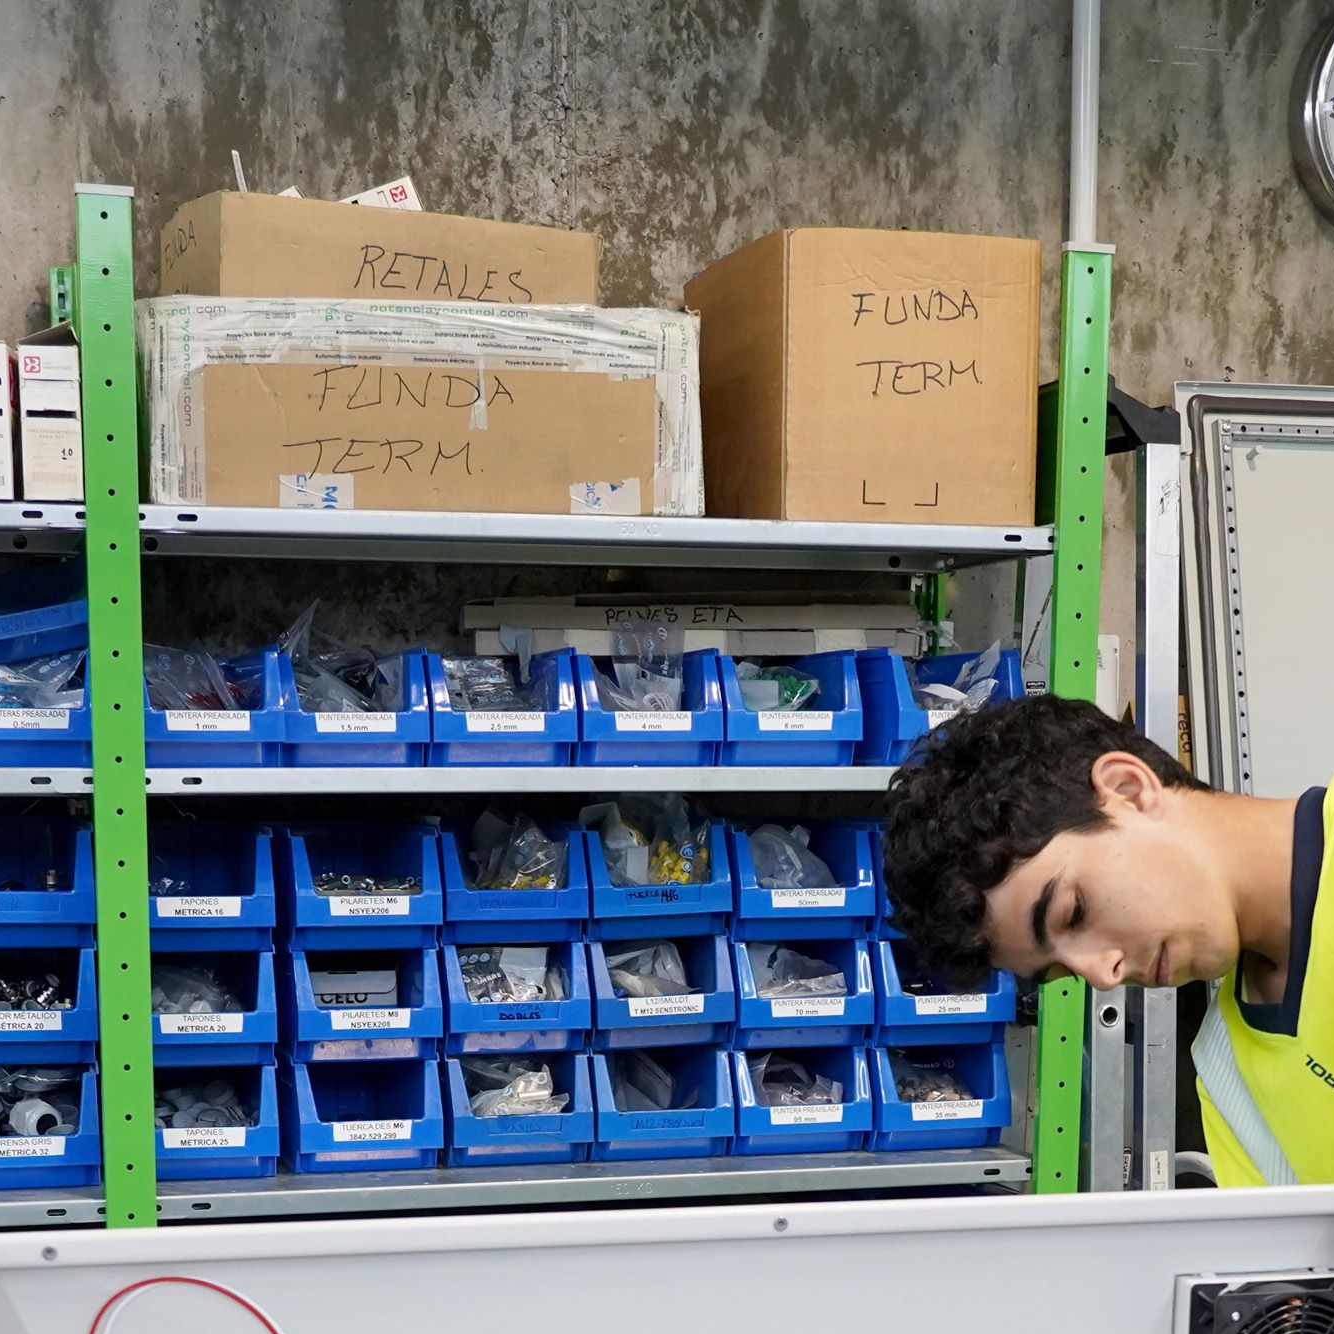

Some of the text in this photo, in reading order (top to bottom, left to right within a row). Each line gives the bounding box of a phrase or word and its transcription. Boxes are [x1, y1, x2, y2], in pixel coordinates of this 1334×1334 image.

[354, 244, 532, 304] RETALES
[851, 290, 978, 326] FUNDA
[856, 360, 983, 396] TERM.
[313, 364, 514, 411] FUNDA
[282, 438, 484, 480] TERM.
[692, 606, 744, 623] ETA
[169, 711, 247, 720] PUNTERA PREAISLADA
[761, 712, 790, 720] PUNTERA
[179, 897, 219, 906] TAPONES
[340, 896, 398, 905] PILARETES M6
[215, 908, 224, 916] 16
[342, 1010, 399, 1019] PILARETES M8
[34, 1022, 44, 1030] 20
